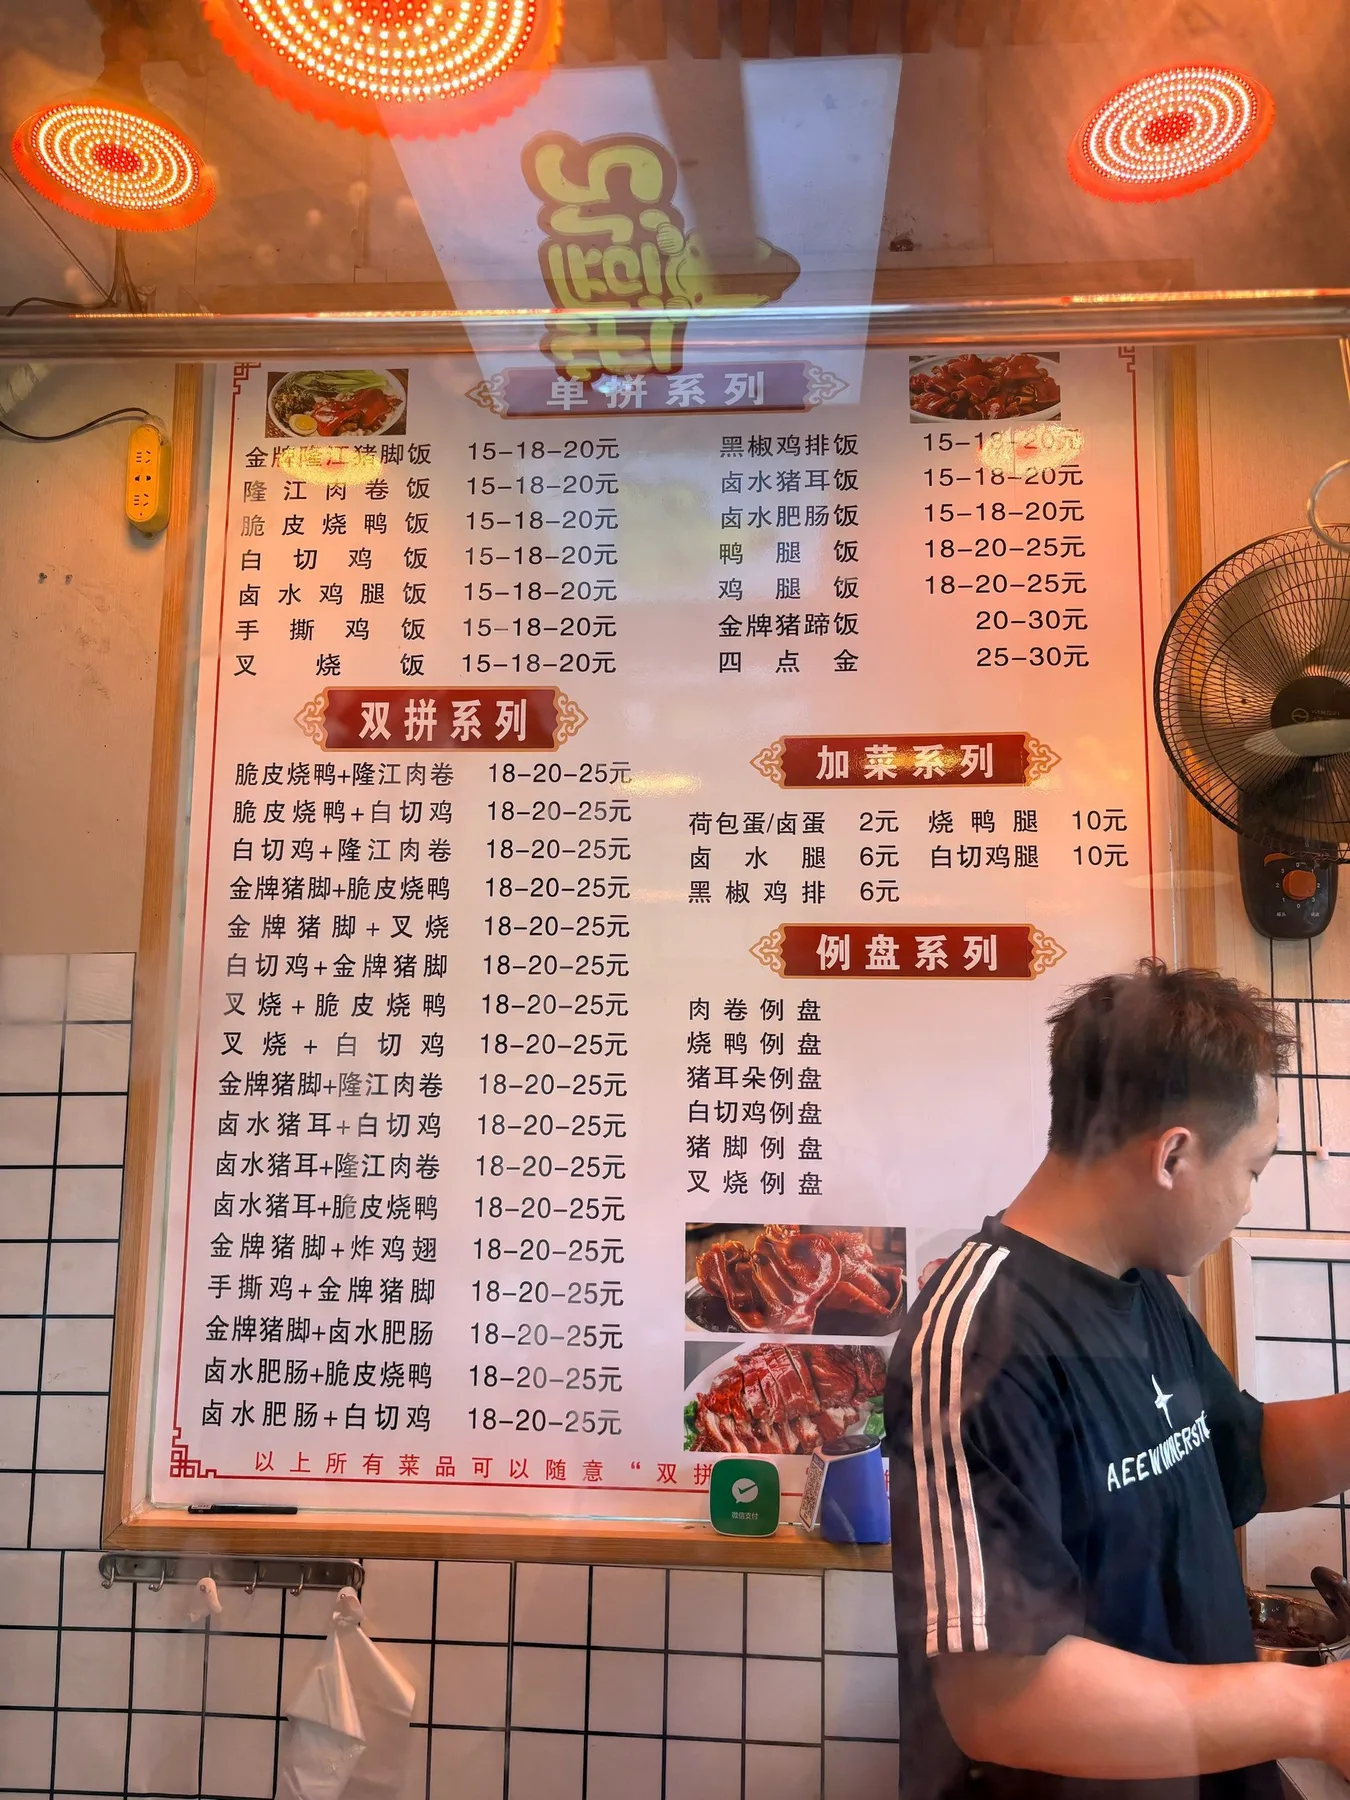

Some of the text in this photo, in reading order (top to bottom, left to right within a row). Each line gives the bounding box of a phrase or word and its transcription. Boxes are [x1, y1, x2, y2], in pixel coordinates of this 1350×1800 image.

[546, 371, 765, 410] 单拼系列
[468, 438, 620, 461] 15-18-20元
[720, 434, 859, 458] 黑椒鸡排饭
[243, 474, 619, 503] 隆江肉卷饭 15-18-20元
[721, 464, 1083, 494] 卤水猪耳饭 15-18-20元
[241, 508, 618, 536] 脆皮烧鸭饭 15-18-20元
[722, 500, 1084, 529] 卤水肥肠饭 15-18-20元
[242, 544, 618, 571] 白切鸡饭 15-18-20元
[720, 536, 1085, 565] 鸭腿饭 18-20-25元
[239, 580, 617, 606] 卤水鸡腿饭 15-18-20元
[718, 572, 1087, 601] 鸡腿饭 18-20-25元
[235, 616, 617, 641] 手撕鸡饭 15-18-20元
[718, 609, 1088, 637] 金牌猪蹄饭 20-30元
[234, 652, 616, 676] 叉烧饭 15-18-20元
[719, 645, 1089, 673] 四点金 25-30元
[359, 698, 527, 743] 双拼系列
[235, 762, 632, 786] 脆皮烧鸭+隆江肉卷 18-20-25元
[816, 743, 993, 781] 加菜系列
[233, 799, 631, 824] 脆皮烧鸭+白切鸡 18-20-25元
[689, 809, 1127, 835] 荷包蛋/卤蛋 2元 烧鸭腿 10元
[234, 837, 631, 862] 白切鸡+隆江肉卷 18-20-25元
[691, 844, 1129, 870] 卤水腿 6元 白切鸡腿 10元
[230, 875, 630, 900] 金牌猪脚+脆皮烧鸭 18-20-25元
[688, 880, 900, 904] 黑椒鸡排 6元
[228, 914, 630, 939] 金牌猪脚+叉烧 18-20-25元
[228, 953, 629, 978] 白切鸡+金牌猪脚 18-20-25元
[816, 933, 997, 971] 例盘系列
[223, 992, 628, 1017] 叉烧+脆皮烧鸭 18-20-25元
[690, 997, 821, 1021] 肉卷例盘
[221, 1031, 628, 1058] 叉烧+白切鸡 18-20-25元
[687, 1031, 821, 1055] 烧鸭例盘
[219, 1070, 627, 1098] 金牌猪脚+隆江肉卷 18-20-25元
[687, 1065, 822, 1090] 猪耳朵例盘
[218, 1110, 626, 1138] 卤水猪耳+白切鸡 18-20-25元
[689, 1100, 822, 1125] 白切鸡例盘
[686, 1134, 822, 1160] 猪脚例盘
[216, 1150, 626, 1180] 卤水猪耳+隆江肉卷 18-20-25元
[687, 1170, 822, 1195] 叉烧例盘
[214, 1191, 625, 1221] 卤水猪耳+脆皮烧鸭 18-20-25元
[210, 1232, 624, 1264] 金牌猪脚+炸鸡翅 18-20-25元
[208, 1274, 624, 1307] 手撕鸡+金牌猪脚 18-20-25元
[206, 1315, 623, 1349] 金牌猪脚+卤水肥肠 18-20-25元
[205, 1356, 622, 1392] 卤水肥肠+脆皮烧鸭 18-20-25元
[202, 1399, 622, 1435] 卤水肥肠+白切鸡 18-20-25元
